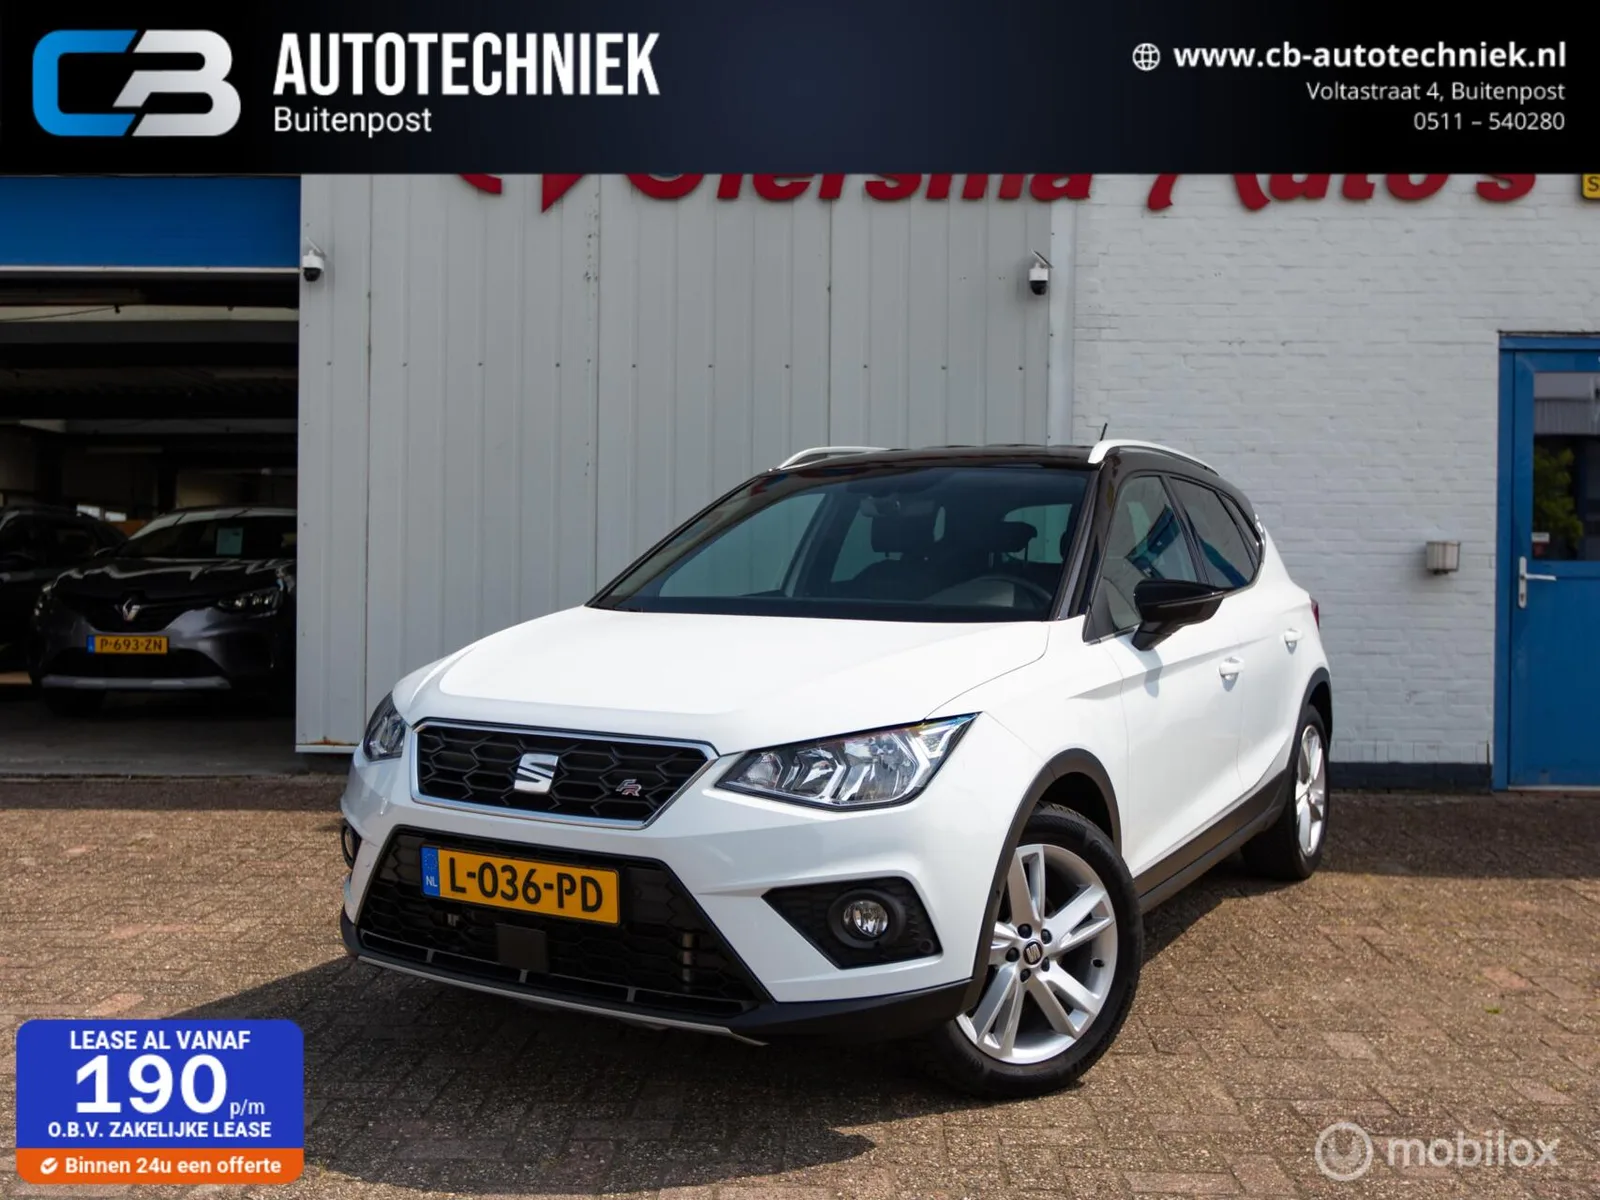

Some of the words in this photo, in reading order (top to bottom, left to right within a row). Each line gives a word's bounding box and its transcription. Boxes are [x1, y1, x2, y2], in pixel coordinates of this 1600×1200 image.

[100, 637, 163, 651] P-693-ZN
[425, 875, 438, 888] NL
[449, 857, 603, 913] L-036-PD
